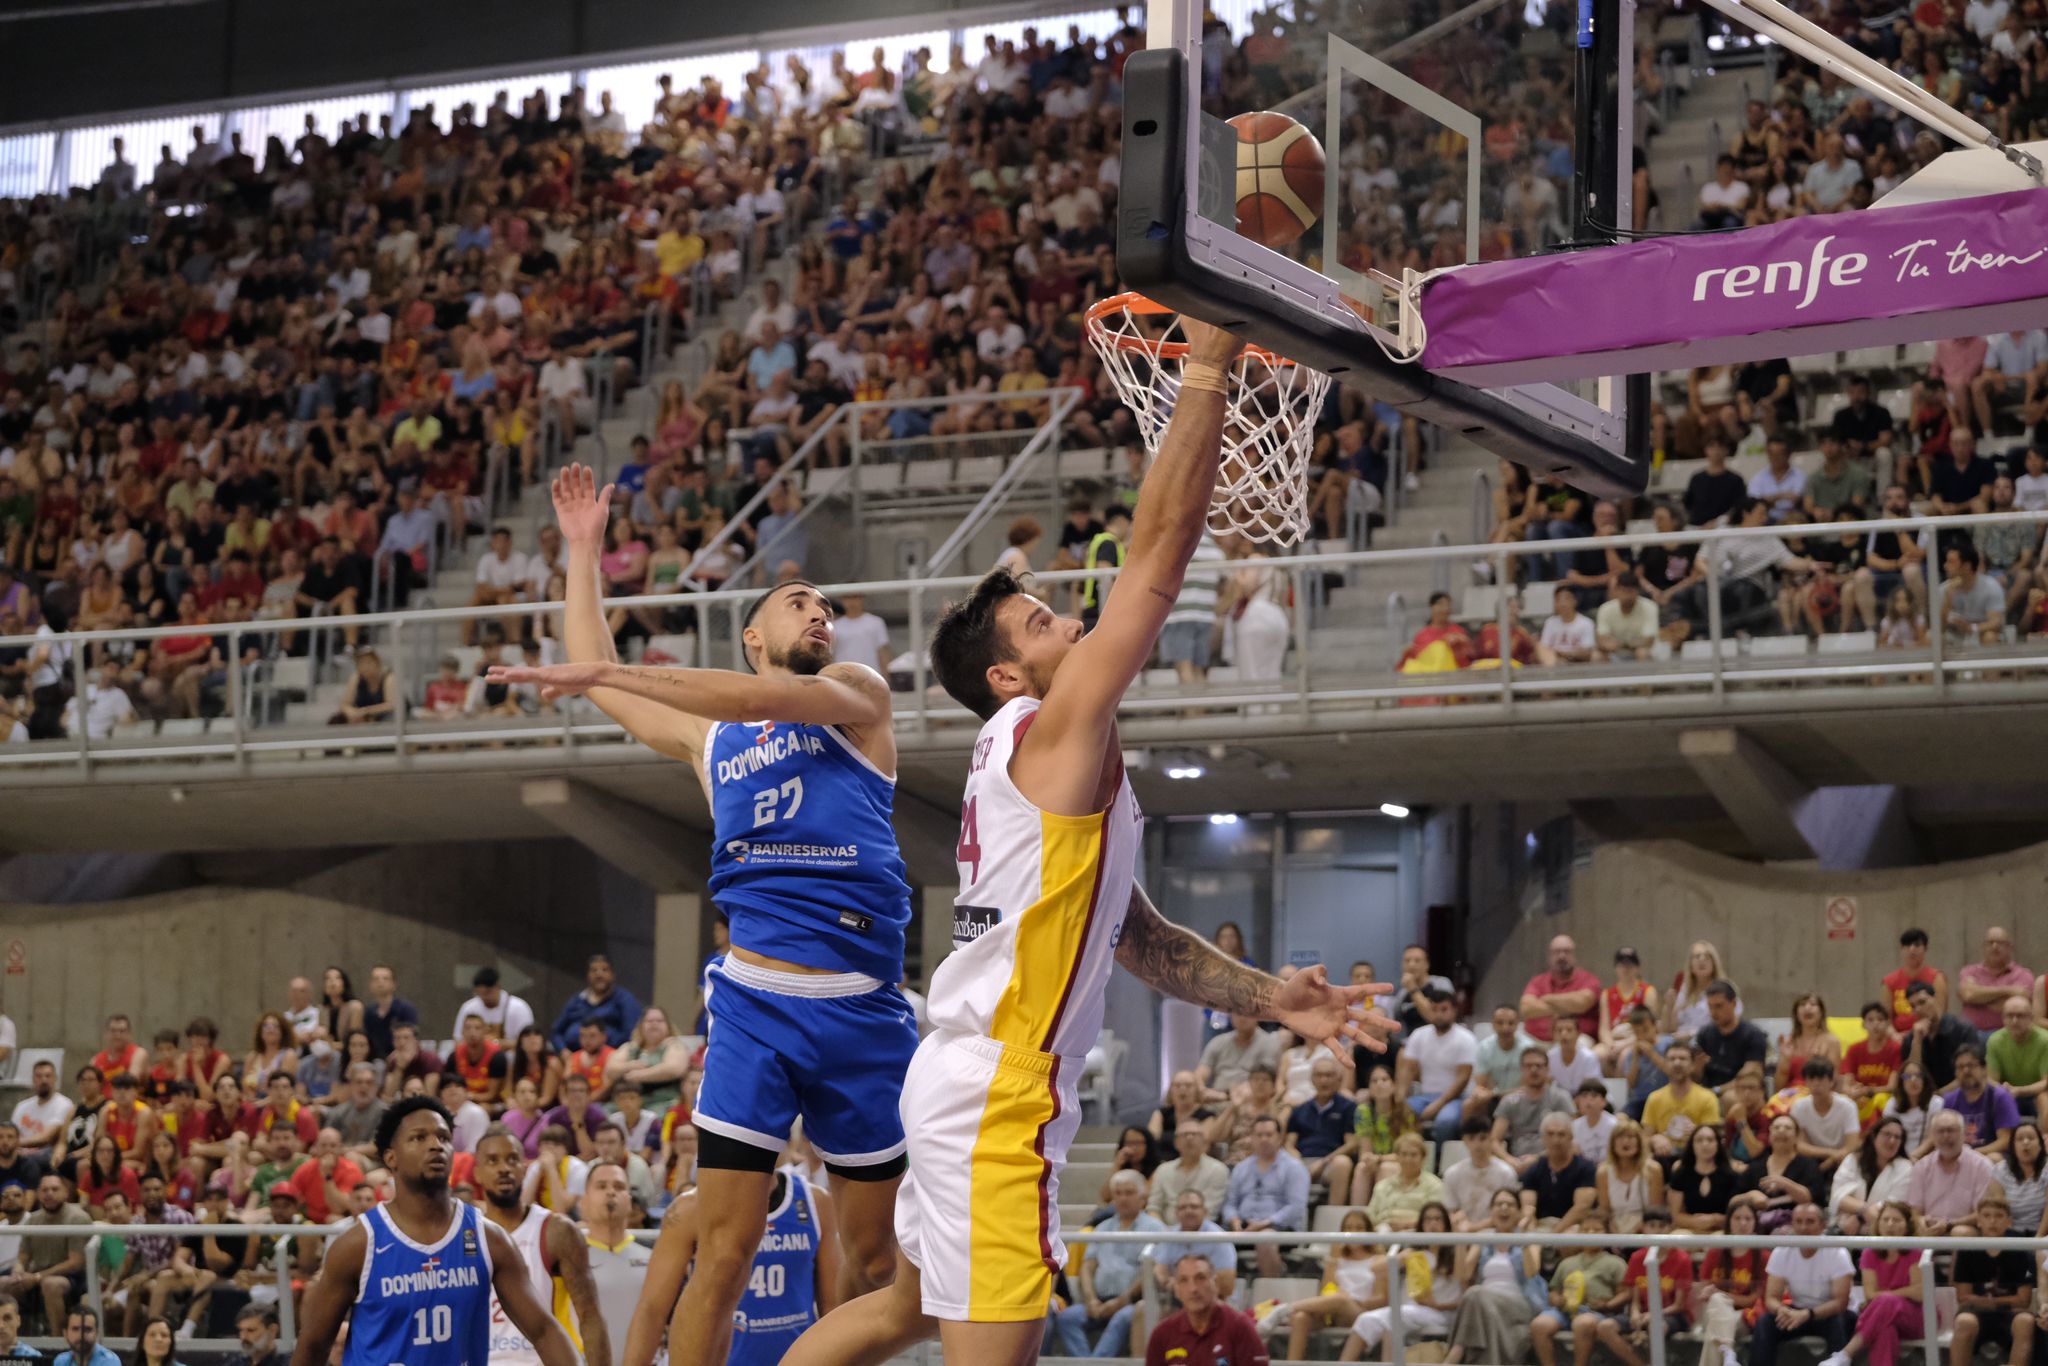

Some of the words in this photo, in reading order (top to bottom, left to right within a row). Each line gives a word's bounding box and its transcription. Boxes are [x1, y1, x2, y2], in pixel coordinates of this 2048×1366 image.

[1693, 235, 1868, 309] renfe
[1889, 239, 1937, 282] Tu
[1946, 239, 2045, 275] tren
[717, 730, 826, 785] DOMINICANA
[753, 776, 804, 829] 27
[752, 844, 858, 857] BANRESERVAS
[956, 795, 981, 886] 4
[816, 859, 858, 867] dominicanos
[381, 1266, 479, 1298] DOMINICANA
[748, 1264, 785, 1298] 40
[413, 1305, 452, 1346] 10
